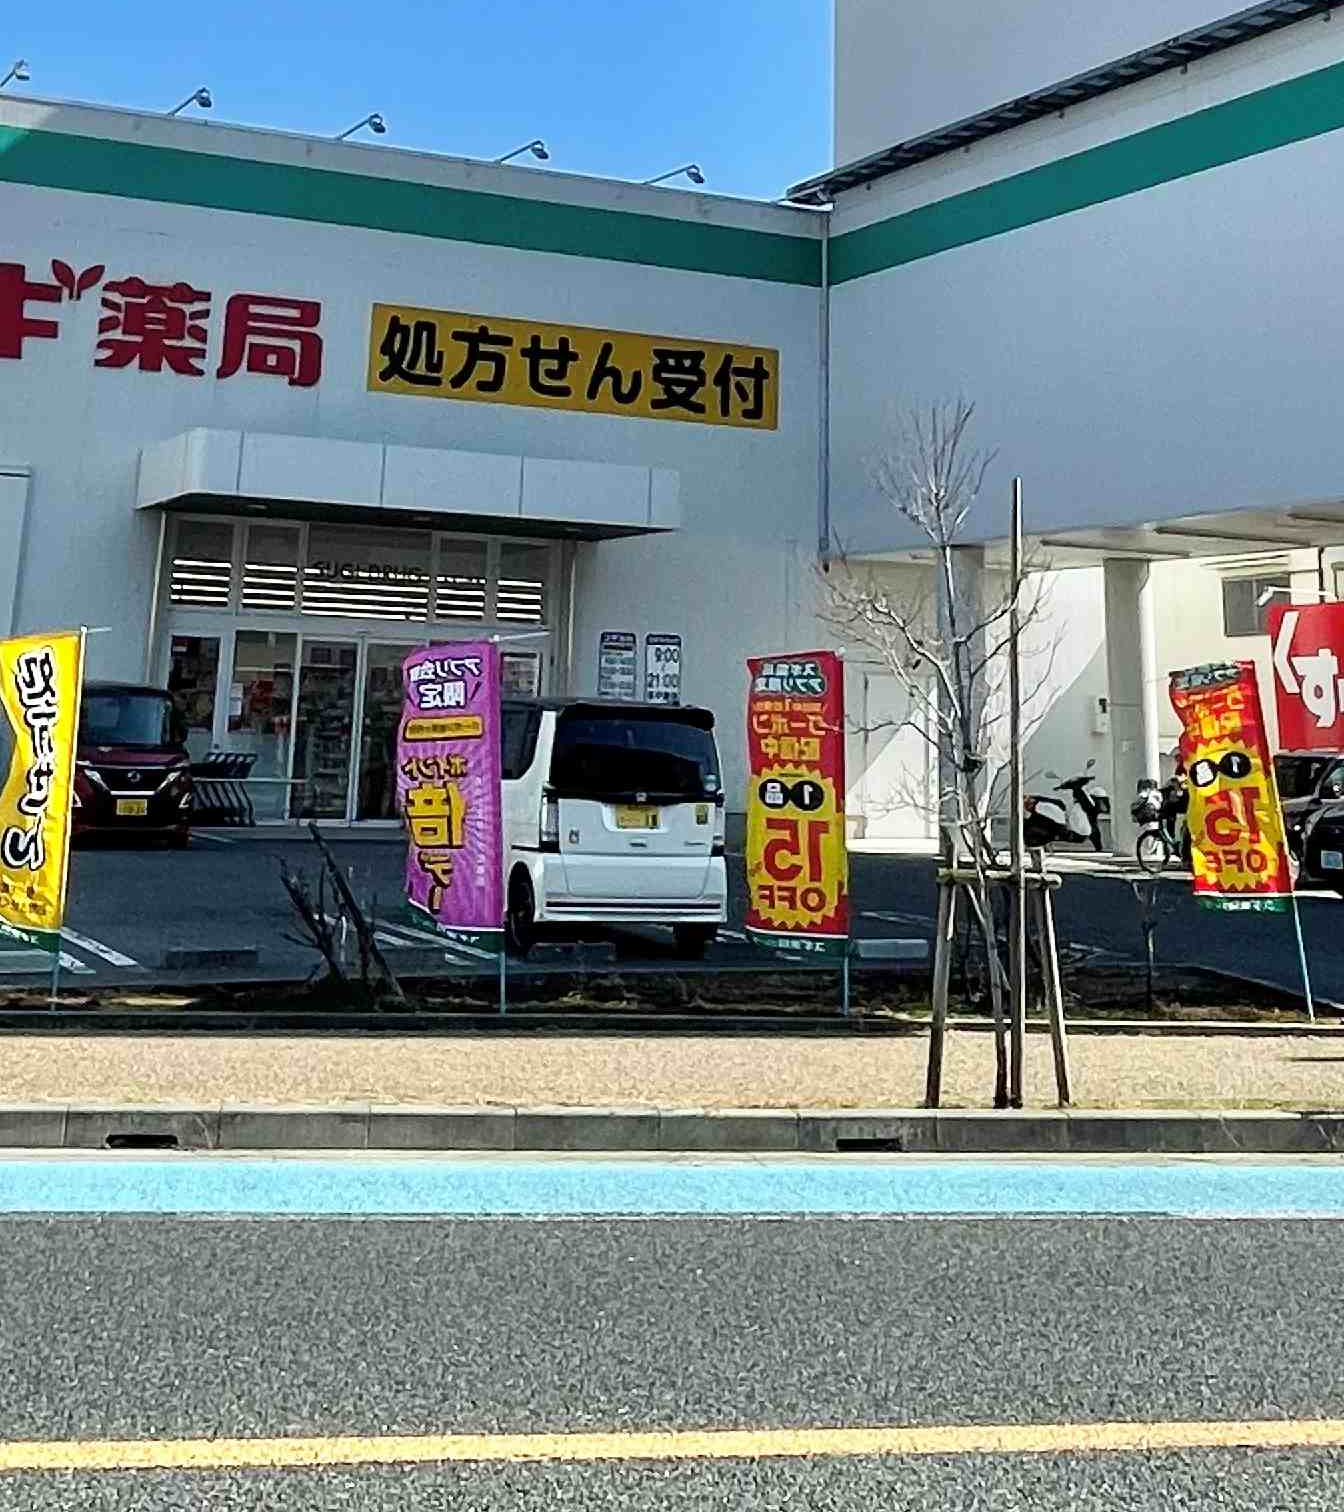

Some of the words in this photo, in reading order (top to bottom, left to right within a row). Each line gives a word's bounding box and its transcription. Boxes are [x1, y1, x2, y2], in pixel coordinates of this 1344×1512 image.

[378, 315, 771, 421] 処方せん受付
